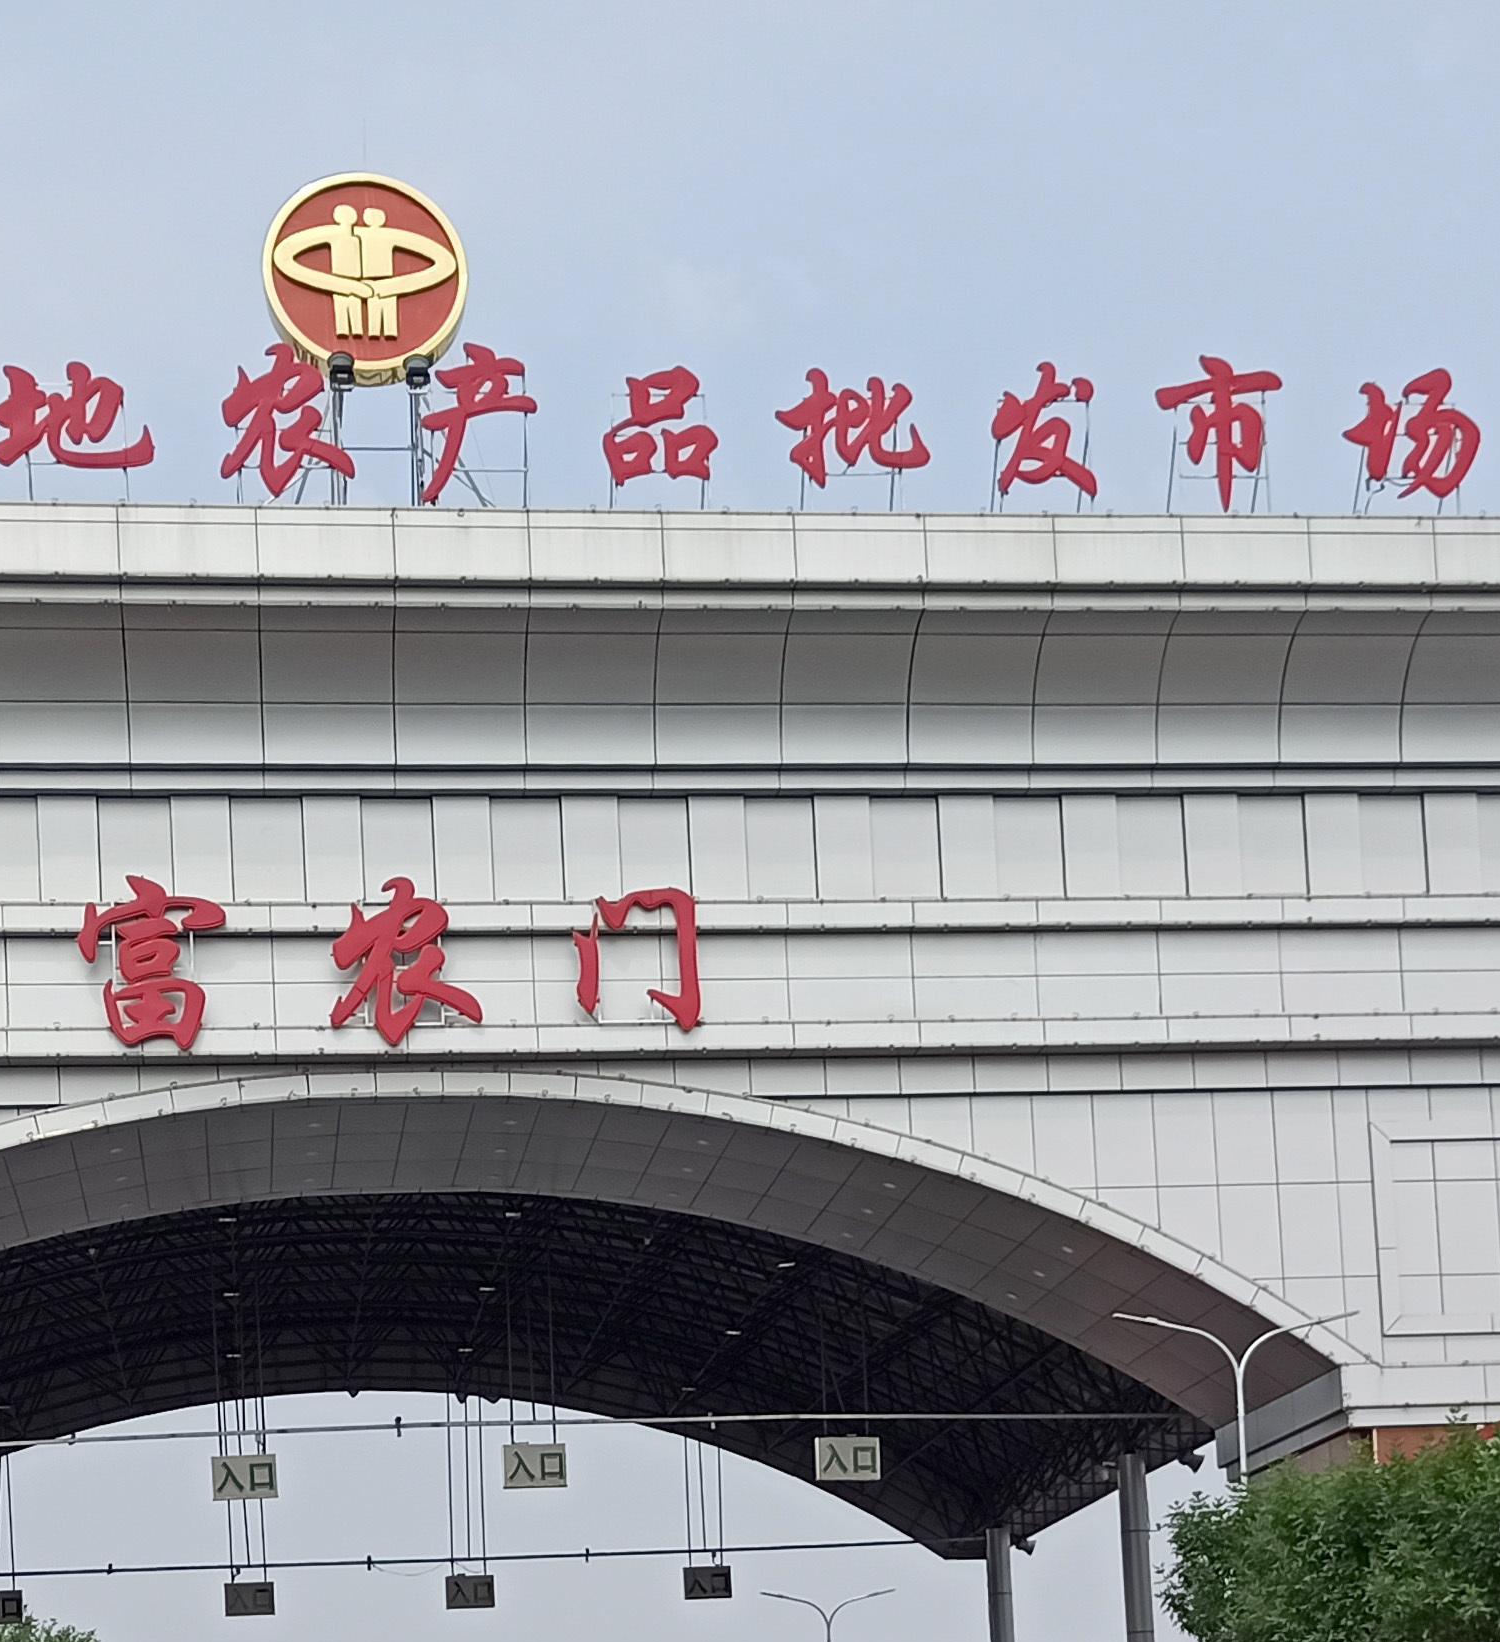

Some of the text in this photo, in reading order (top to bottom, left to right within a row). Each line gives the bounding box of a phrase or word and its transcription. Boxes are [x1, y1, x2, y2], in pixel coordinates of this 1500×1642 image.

[77, 874, 701, 1051] 富农门
[509, 1451, 566, 1482] 入口
[822, 1443, 878, 1475] 入口
[215, 1462, 275, 1492] 入口
[229, 1588, 272, 1610] 入口
[452, 1581, 492, 1603] 入口
[688, 1573, 731, 1595] 入口
